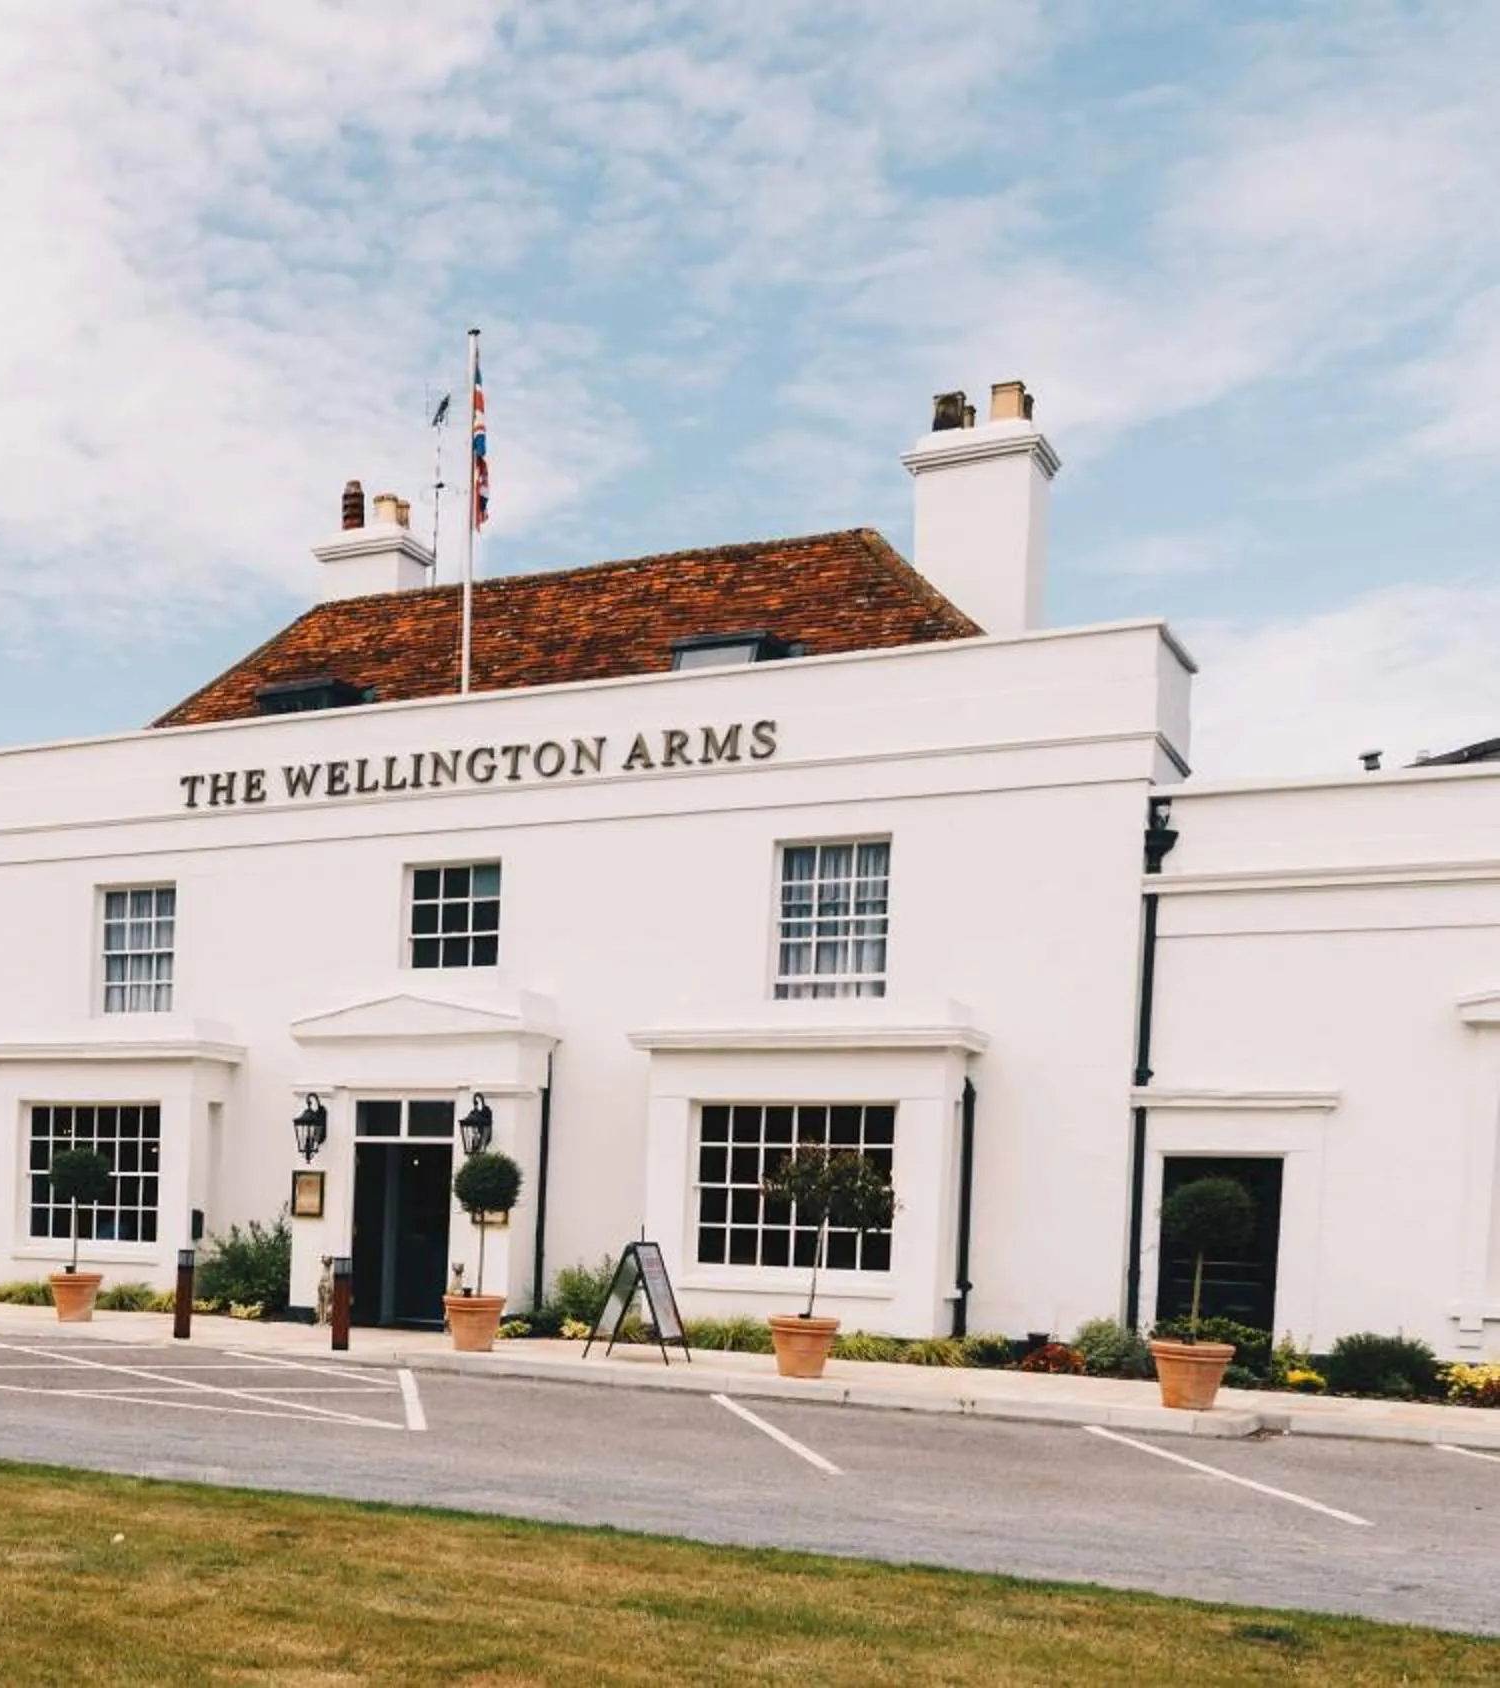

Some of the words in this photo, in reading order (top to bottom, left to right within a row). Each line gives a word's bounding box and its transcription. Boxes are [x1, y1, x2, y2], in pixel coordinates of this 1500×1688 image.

[180, 769, 266, 808] THE
[283, 737, 607, 798] WELLINGTON
[622, 720, 776, 771] ARMS
